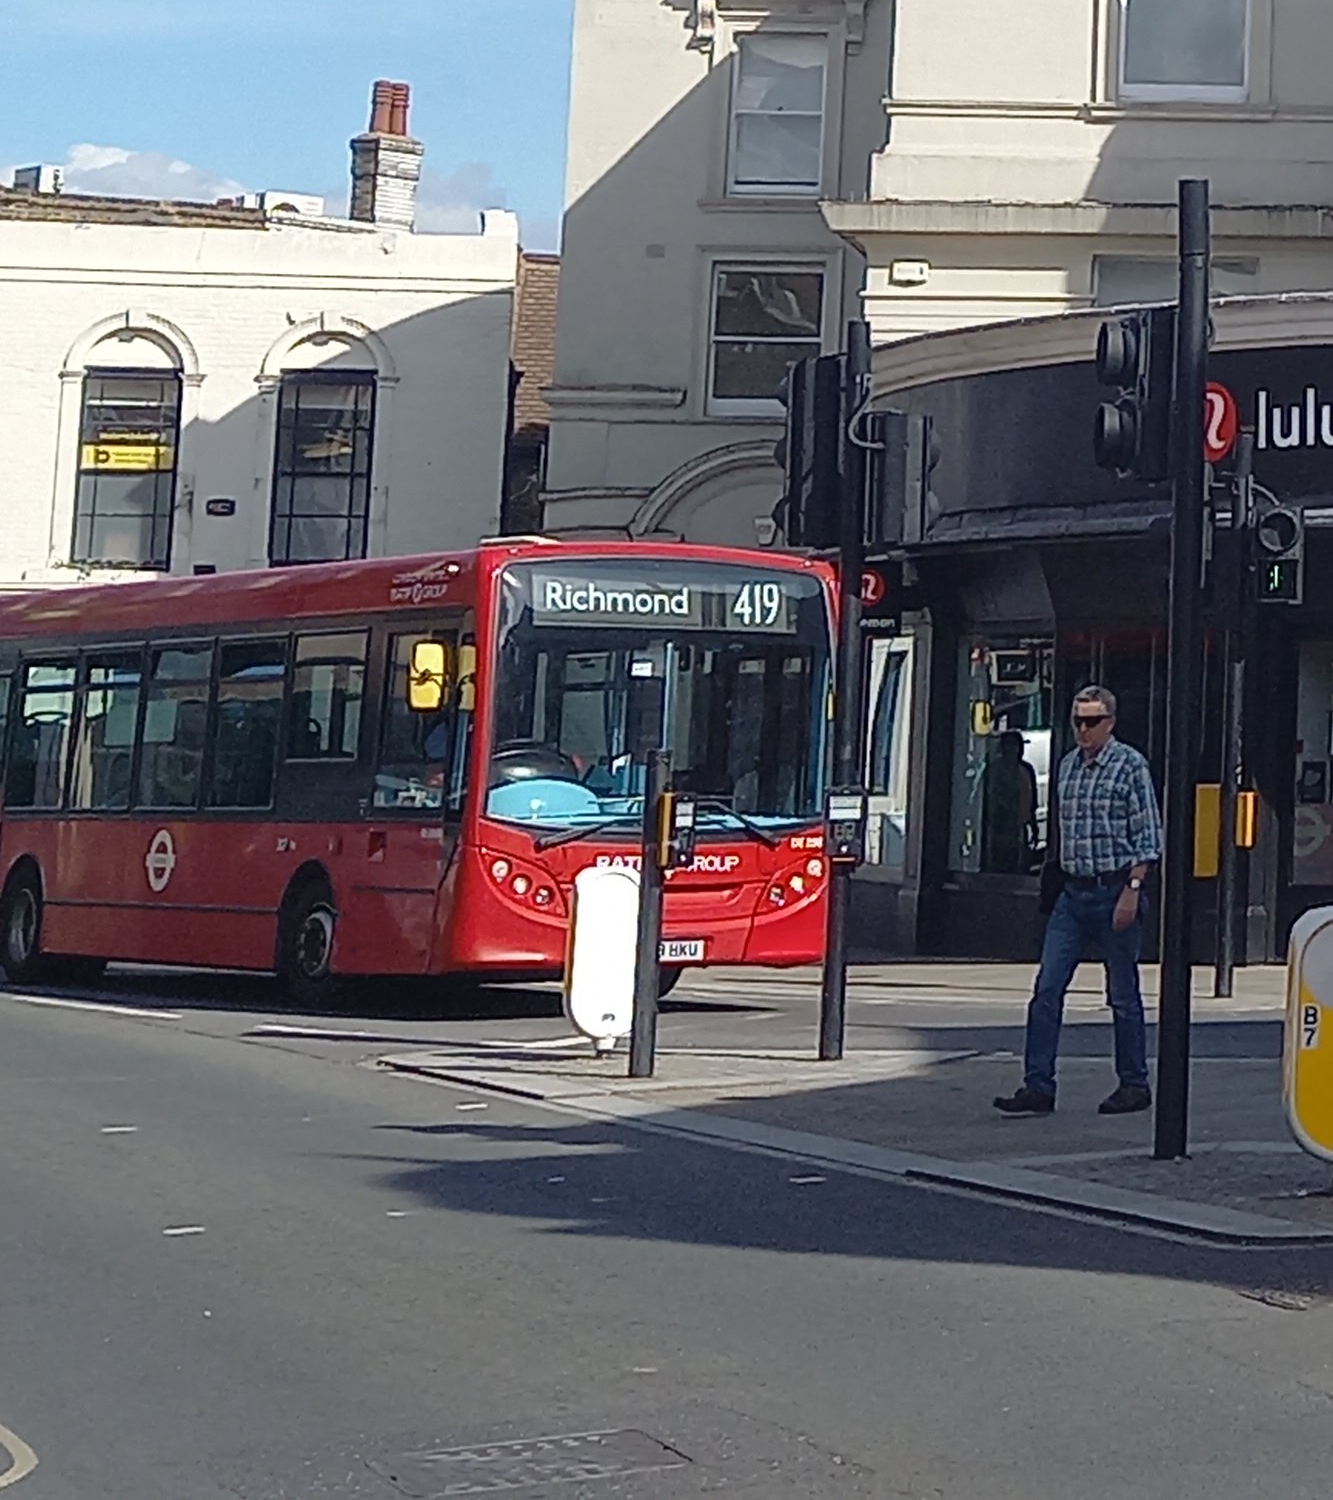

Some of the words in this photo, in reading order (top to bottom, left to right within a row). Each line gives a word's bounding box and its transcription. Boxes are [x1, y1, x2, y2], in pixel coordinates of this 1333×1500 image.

[545, 581, 690, 615] Richmond
[733, 583, 780, 625] 419
[688, 855, 740, 872] ROUP
[1303, 1005, 1319, 1026] B
[1303, 1027, 1317, 1047] 7
